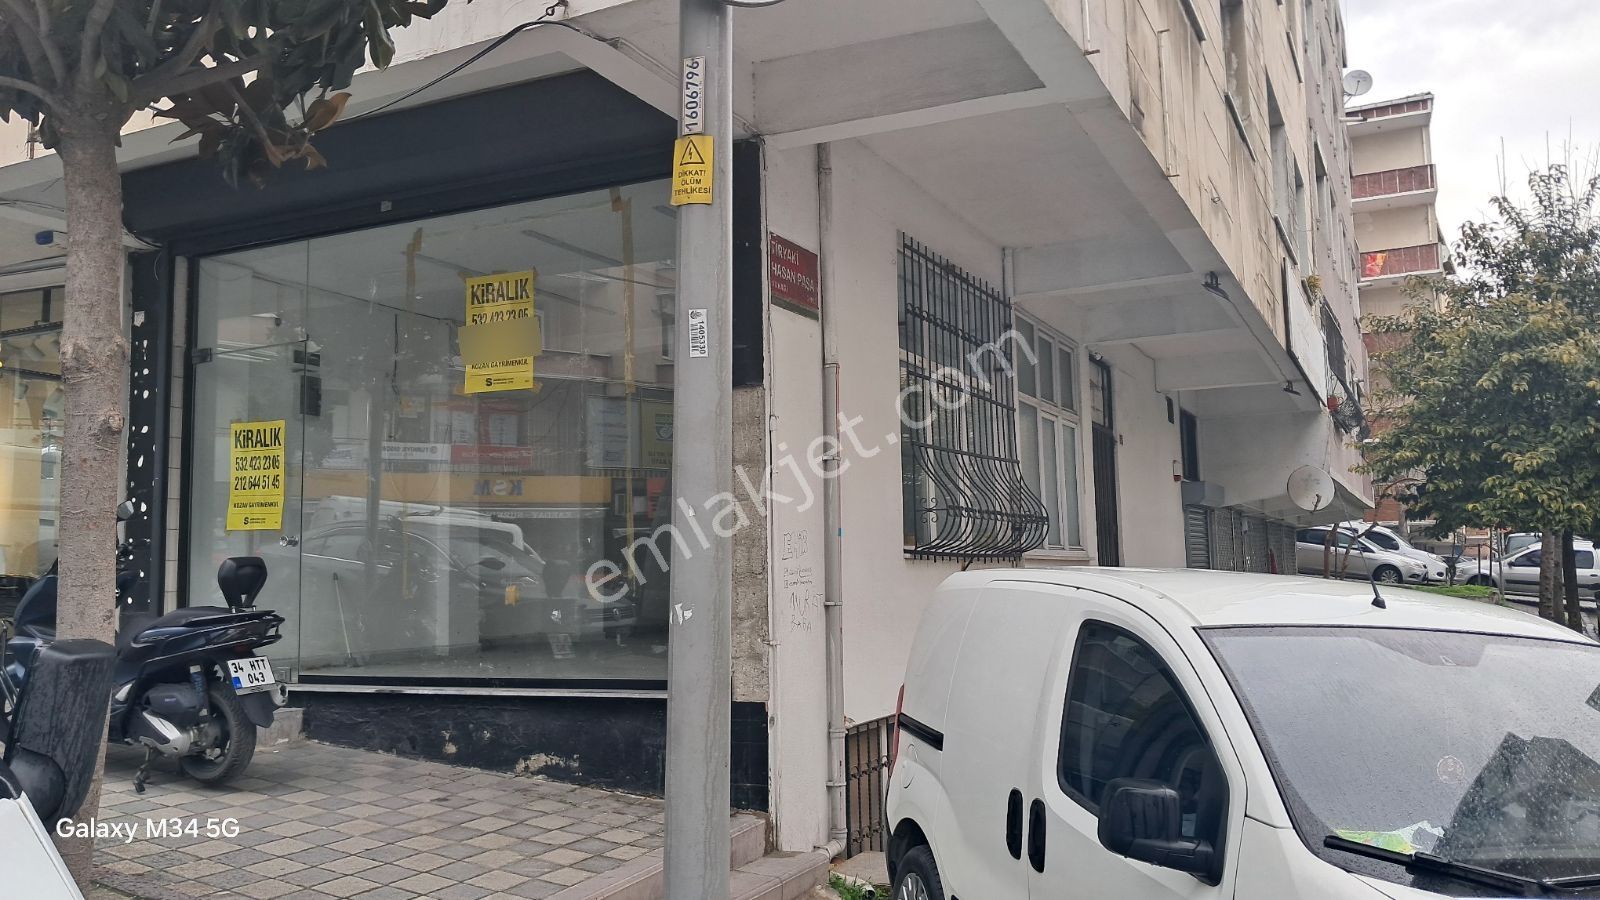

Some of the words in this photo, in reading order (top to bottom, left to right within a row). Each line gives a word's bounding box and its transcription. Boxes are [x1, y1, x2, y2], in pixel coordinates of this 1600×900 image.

[685, 59, 700, 132] 1606796
[680, 177, 702, 187] ÖLÜM
[771, 261, 796, 283] HASAN
[698, 320, 706, 355] 1405330
[235, 456, 248, 471] 532
[249, 456, 262, 470] 423
[263, 455, 271, 470] 23
[272, 454, 281, 470] 05
[234, 476, 247, 490] 212
[248, 475, 261, 490] 644
[262, 474, 270, 489] 51
[272, 474, 280, 489] 45
[231, 661, 244, 673] 34
[249, 659, 266, 671] HTT
[247, 672, 266, 684] 043
